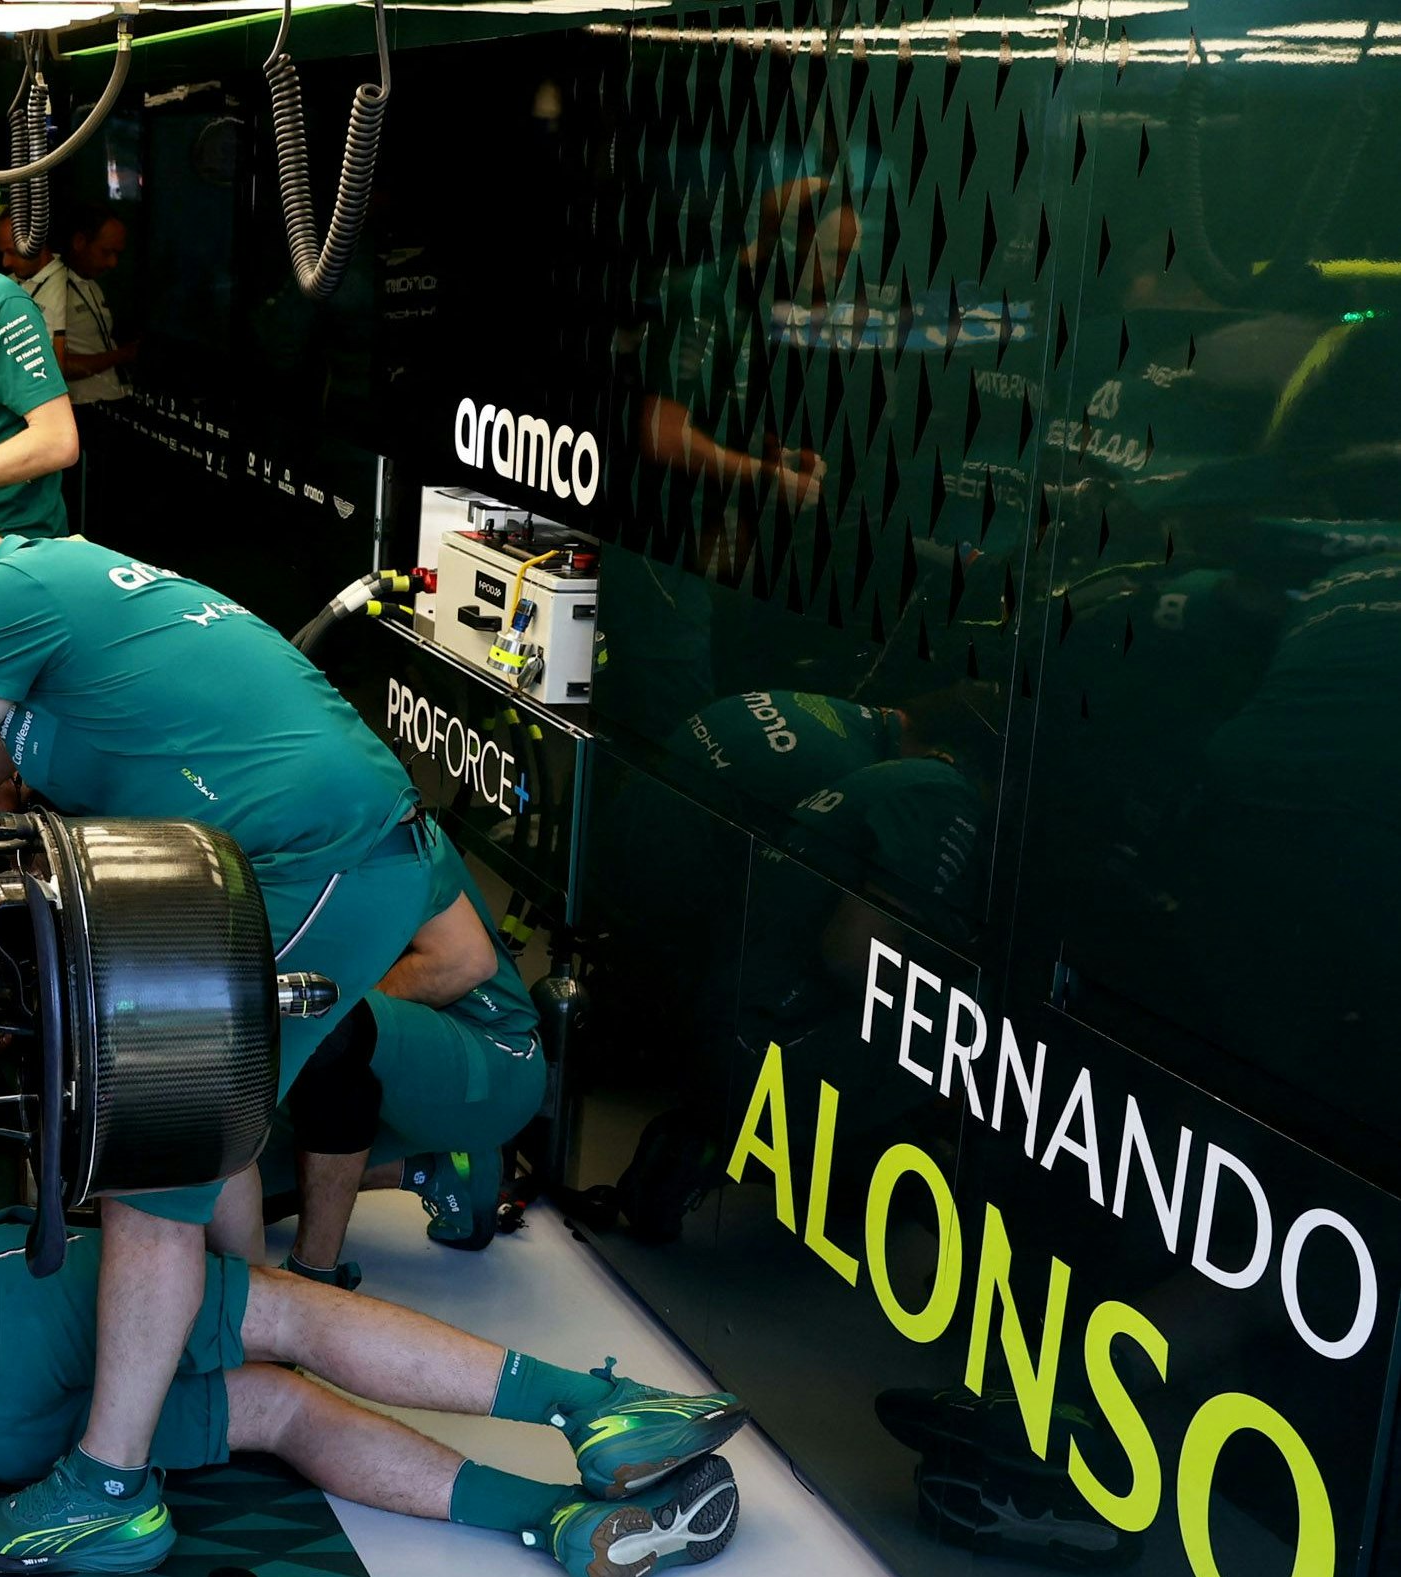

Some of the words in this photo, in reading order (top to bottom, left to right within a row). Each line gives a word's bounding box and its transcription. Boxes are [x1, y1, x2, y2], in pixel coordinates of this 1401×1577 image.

[455, 397, 599, 506] aramco
[12, 710, 34, 766] CoreWeave
[861, 937, 1378, 1360] FERNANDO
[726, 1041, 1335, 1577] ALONSO
